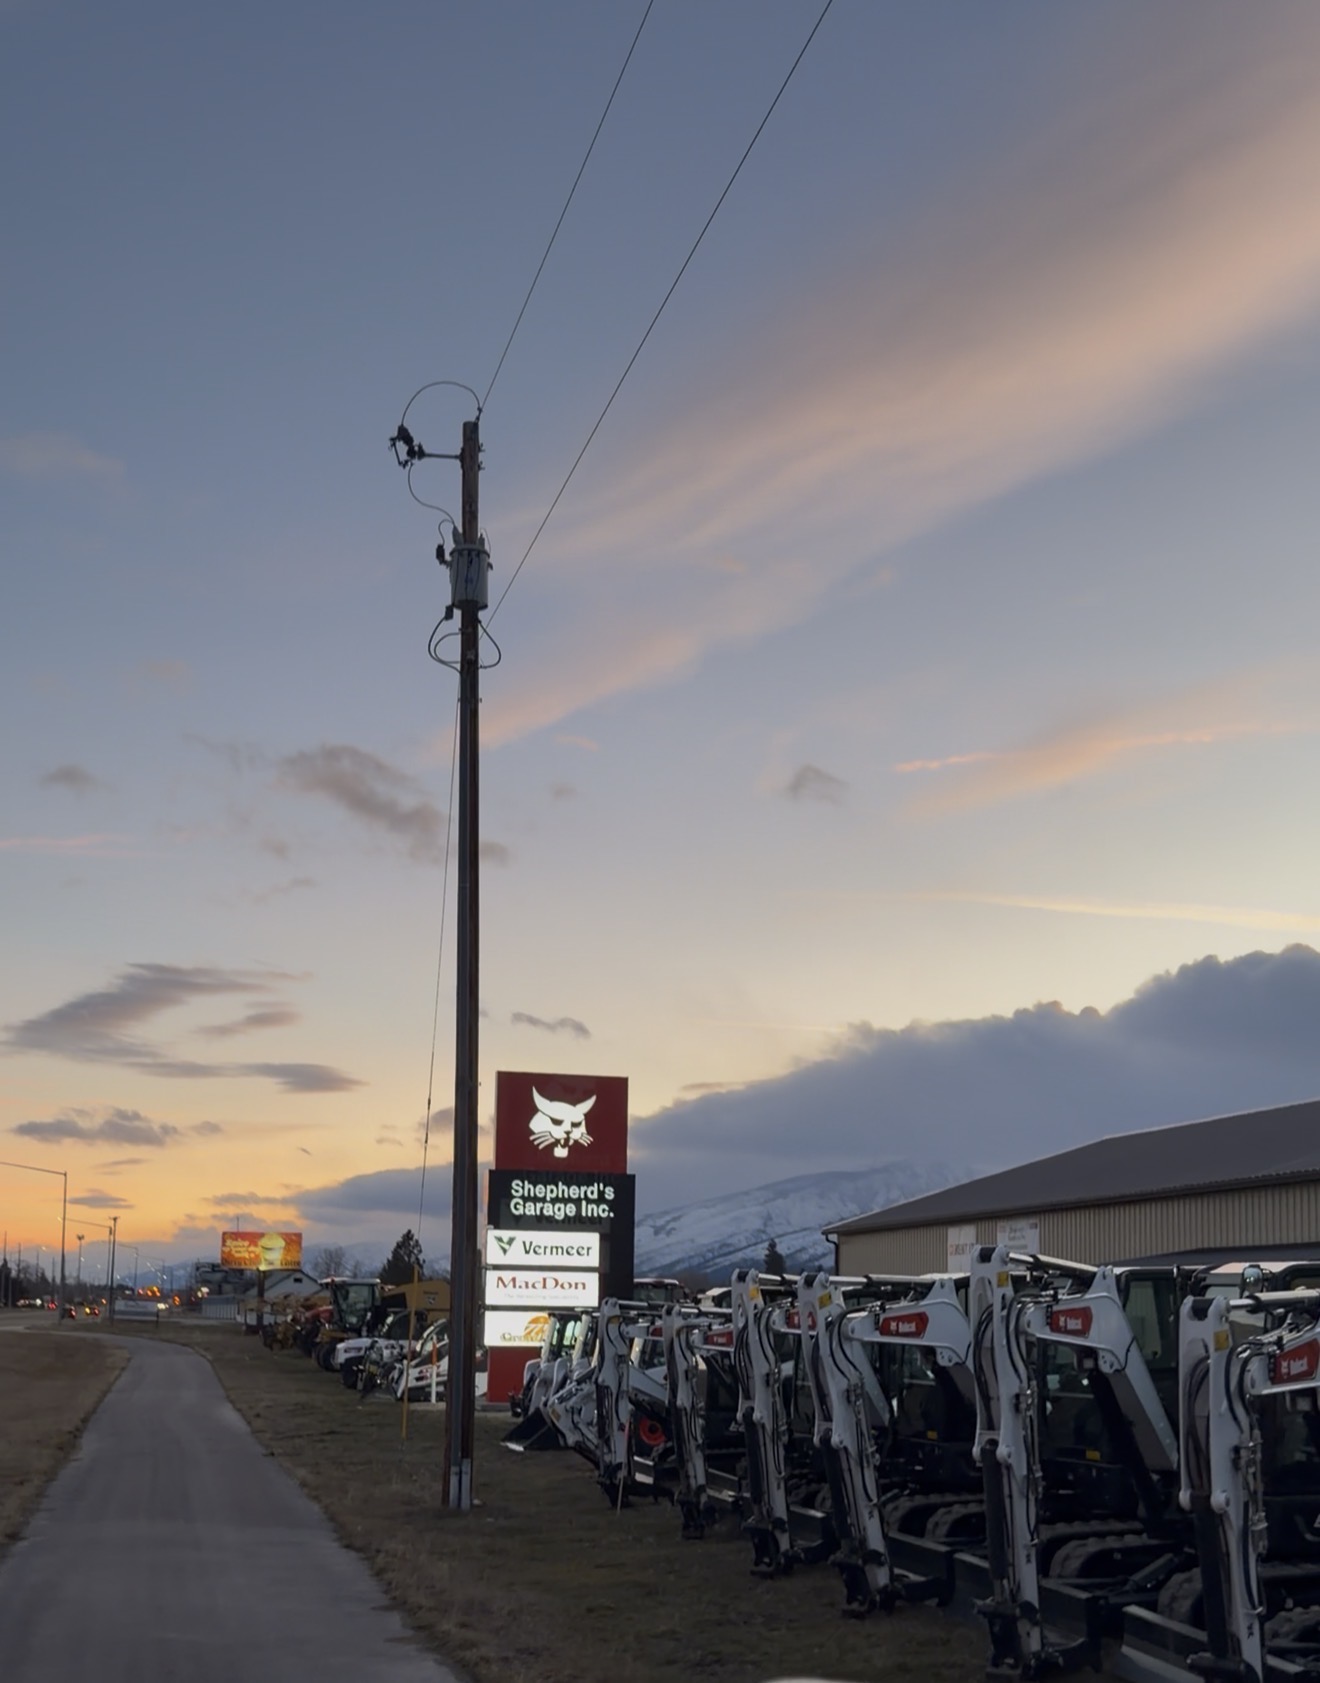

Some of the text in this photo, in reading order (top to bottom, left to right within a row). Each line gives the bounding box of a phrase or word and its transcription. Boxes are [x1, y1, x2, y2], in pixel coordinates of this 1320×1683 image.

[511, 1180, 615, 1201] Shepherd's
[510, 1198, 615, 1220] Garage Inc.
[522, 1240, 593, 1257] Vermeer
[496, 1275, 587, 1291] MacDon
